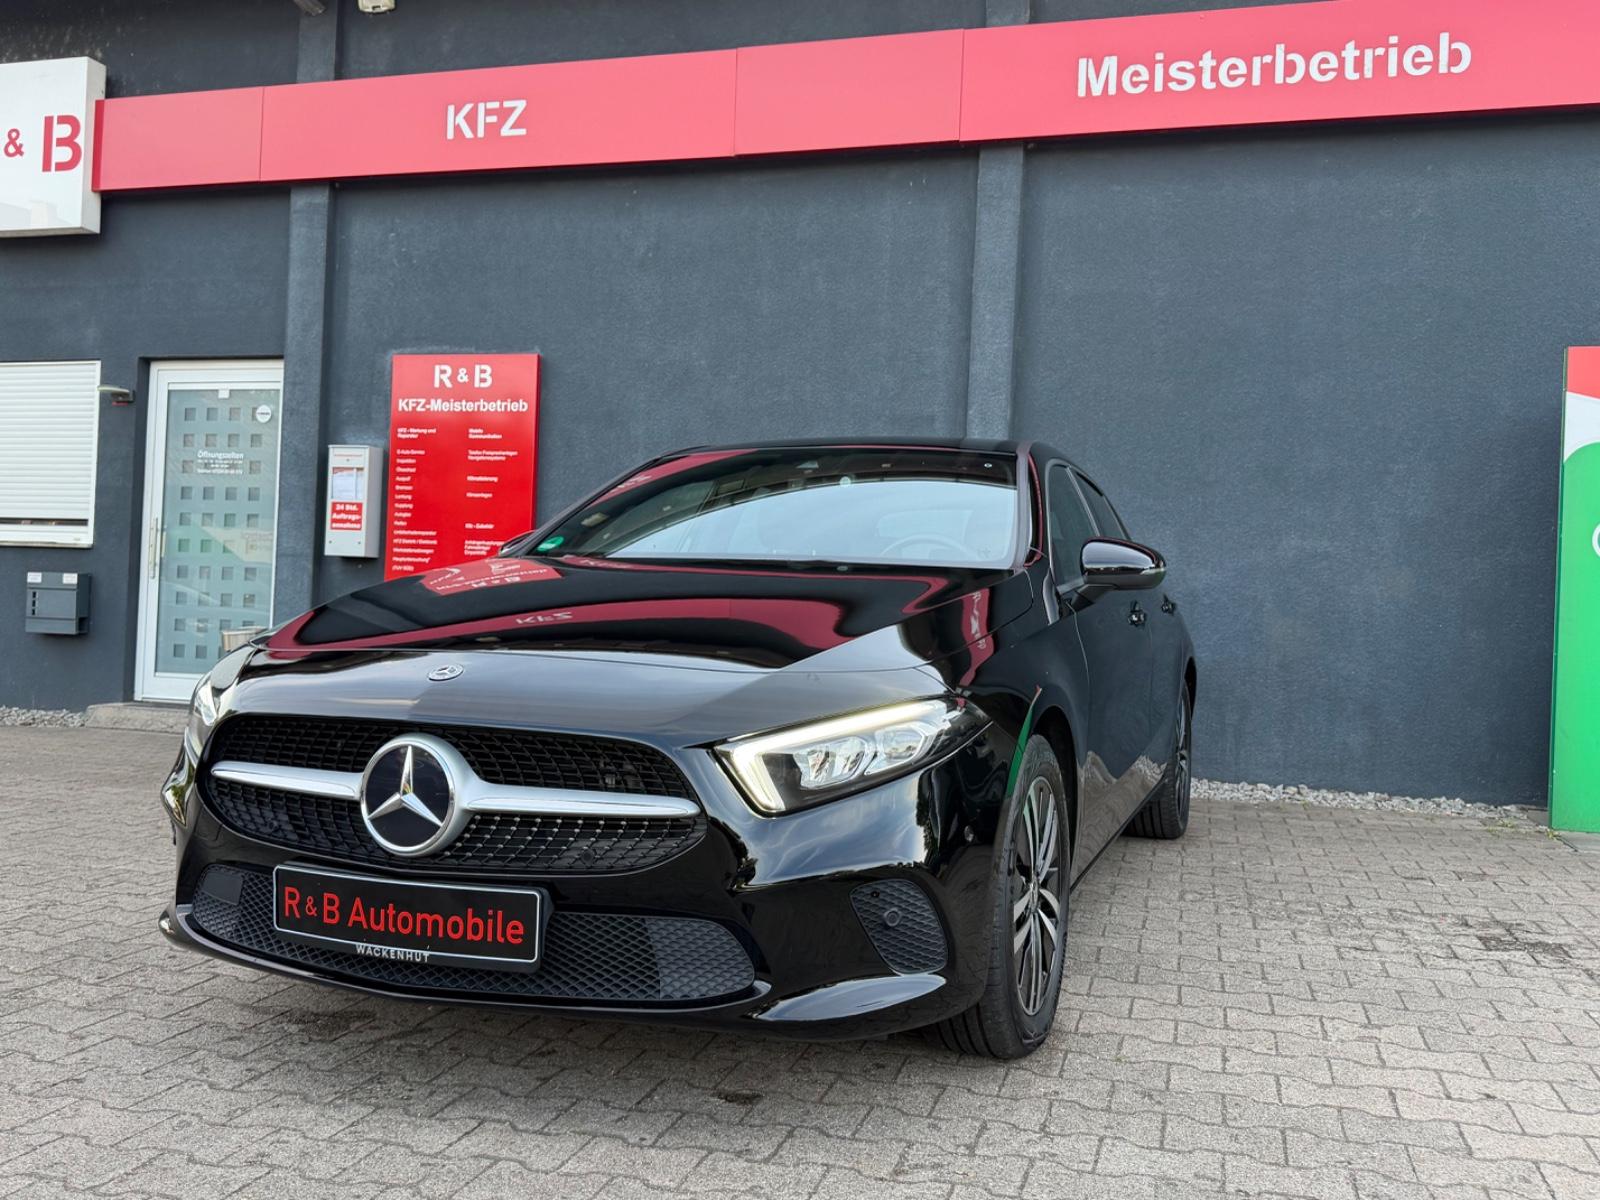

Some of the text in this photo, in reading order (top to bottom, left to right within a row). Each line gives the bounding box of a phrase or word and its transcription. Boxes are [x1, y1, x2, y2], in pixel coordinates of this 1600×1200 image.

[446, 32, 1472, 140] KFZ Meisterbetrieb
[3, 114, 82, 172] & B
[434, 364, 493, 388] R & B
[398, 398, 528, 412] KFZ-Meisterbetrieb
[284, 886, 524, 944] R & B Automobile
[355, 943, 430, 963] WACKENHUT
